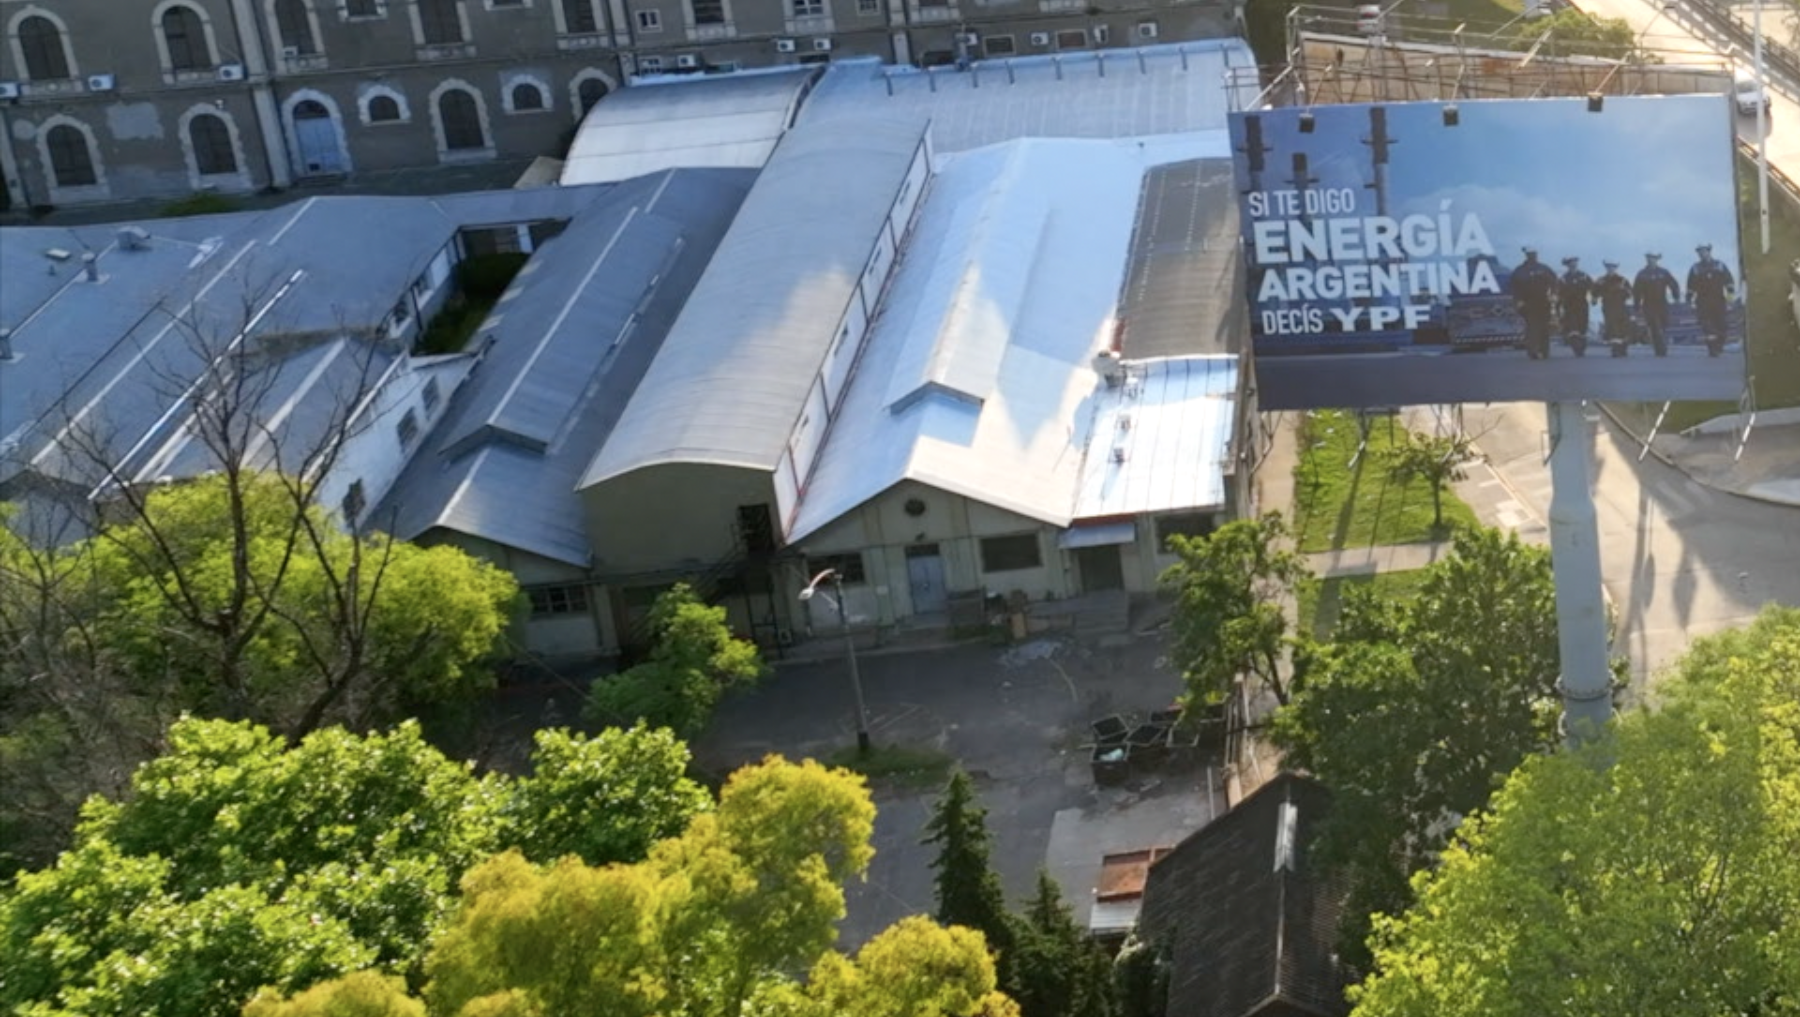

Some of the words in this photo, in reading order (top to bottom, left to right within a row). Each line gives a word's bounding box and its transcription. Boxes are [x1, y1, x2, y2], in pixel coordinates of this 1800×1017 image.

[1249, 191, 1270, 217] SI
[1273, 190, 1300, 216] TE
[1304, 188, 1355, 215] DIGO
[1253, 199, 1496, 264] ENERGÍA
[1258, 260, 1502, 302] ARGENTINA
[1262, 303, 1324, 335] DECÍS
[1329, 304, 1433, 332] YPF
